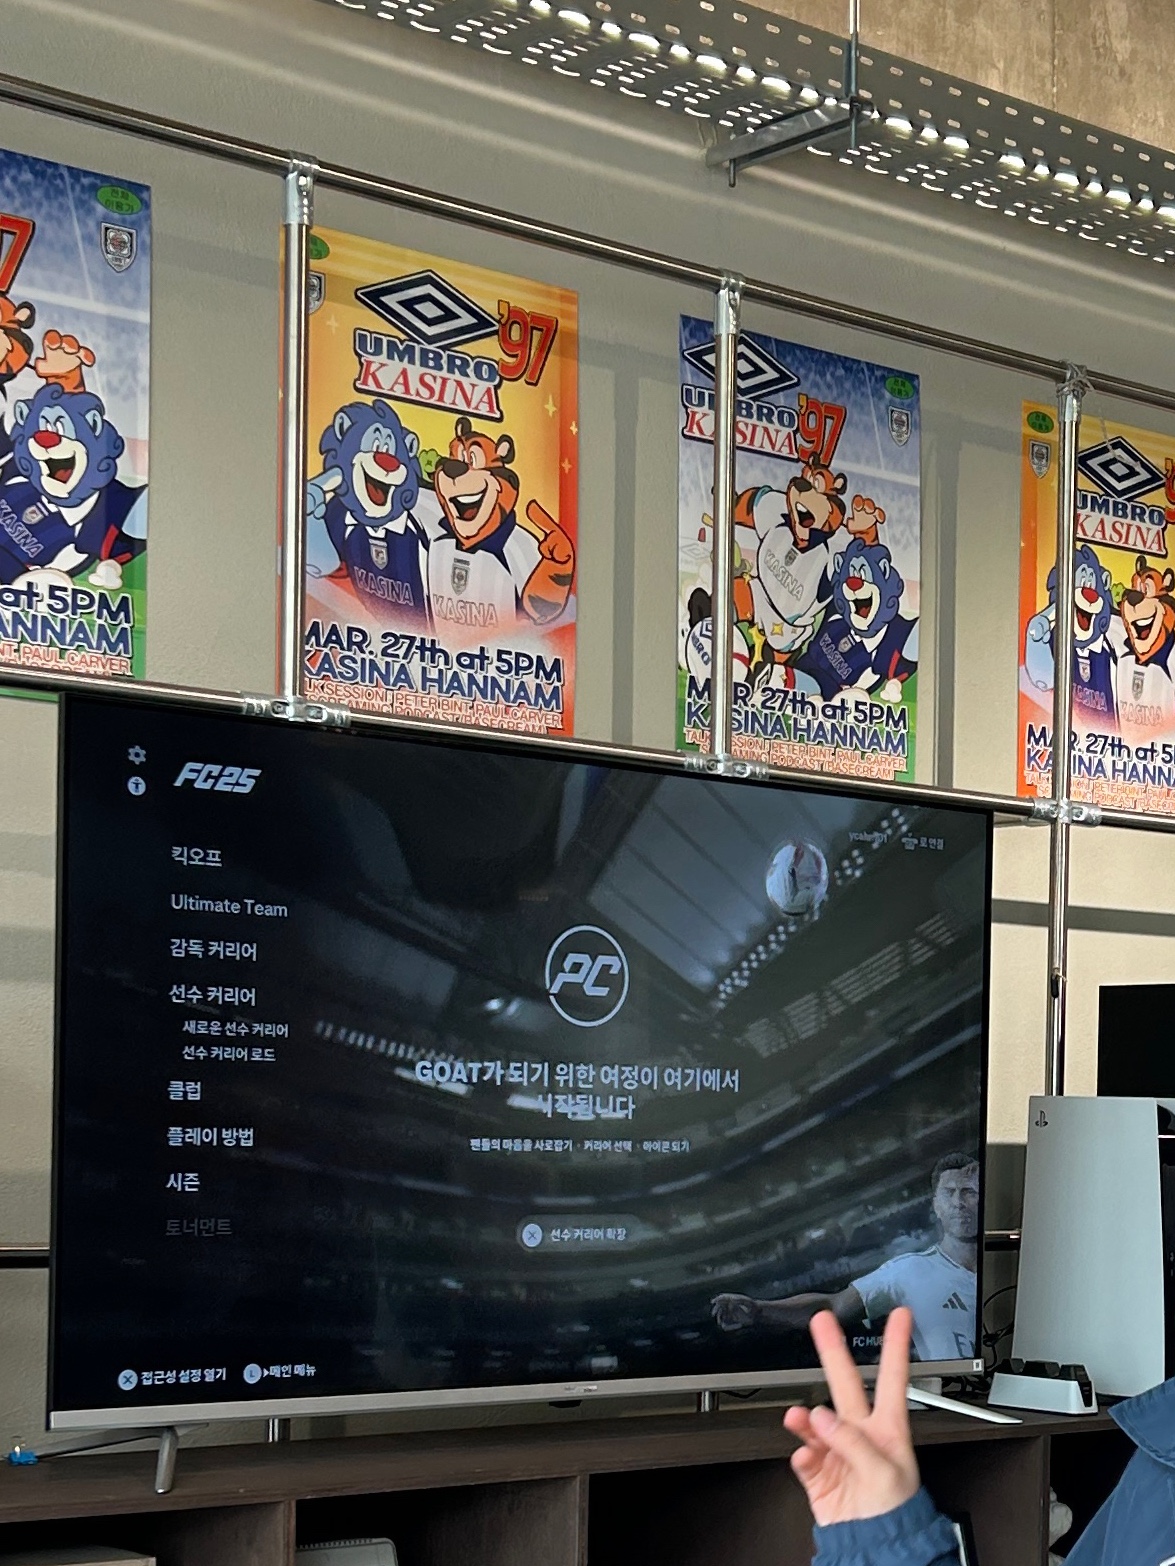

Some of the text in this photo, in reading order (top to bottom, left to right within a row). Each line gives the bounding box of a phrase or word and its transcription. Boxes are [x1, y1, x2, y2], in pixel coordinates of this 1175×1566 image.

[355, 330, 499, 383] UMBRO
[359, 358, 498, 415] KASINA
[683, 384, 797, 427] UBRO
[687, 409, 797, 456] KSINA
[1076, 491, 1166, 527] UMBRO
[1076, 512, 1164, 552] KASINA
[353, 565, 414, 607] KASINA
[763, 548, 804, 600] KASINA
[46, 583, 132, 625] 5PM
[432, 593, 499, 628] KASINA
[22, 645, 60, 664] PAUL
[66, 651, 129, 673] CARVER
[381, 631, 450, 668] 27th
[455, 646, 491, 673] at
[495, 650, 563, 684] 5PM
[819, 633, 853, 681] KASINA
[325, 682, 561, 729] SESSION PETER PAUL CARVER
[421, 667, 562, 711] HANNAM
[687, 676, 908, 731] MR. 27th at 5PM
[687, 701, 907, 757] KSINA HANNAM
[771, 741, 808, 757] PETER
[838, 750, 863, 765] PAUL
[1085, 732, 1131, 759] 27th
[1134, 741, 1157, 762] at
[173, 761, 262, 794] FC25
[171, 846, 223, 867] 킥오프
[171, 893, 288, 917] Ultimate Team
[170, 938, 257, 961] 감독 커리어
[169, 984, 256, 1006] 선수 커리어
[182, 1019, 289, 1038] 새로운 선수 커리어
[182, 1045, 276, 1062] 선수 커리어 로드
[167, 1080, 201, 1101] 클럽
[414, 1060, 740, 1093] GOAT가 되기 위한 여정이 여기에서
[166, 1126, 254, 1147] 플레이 방법
[165, 1172, 200, 1192] 시즌
[165, 1217, 233, 1237] 토너먼트
[178, 1369, 202, 1384] 설정
